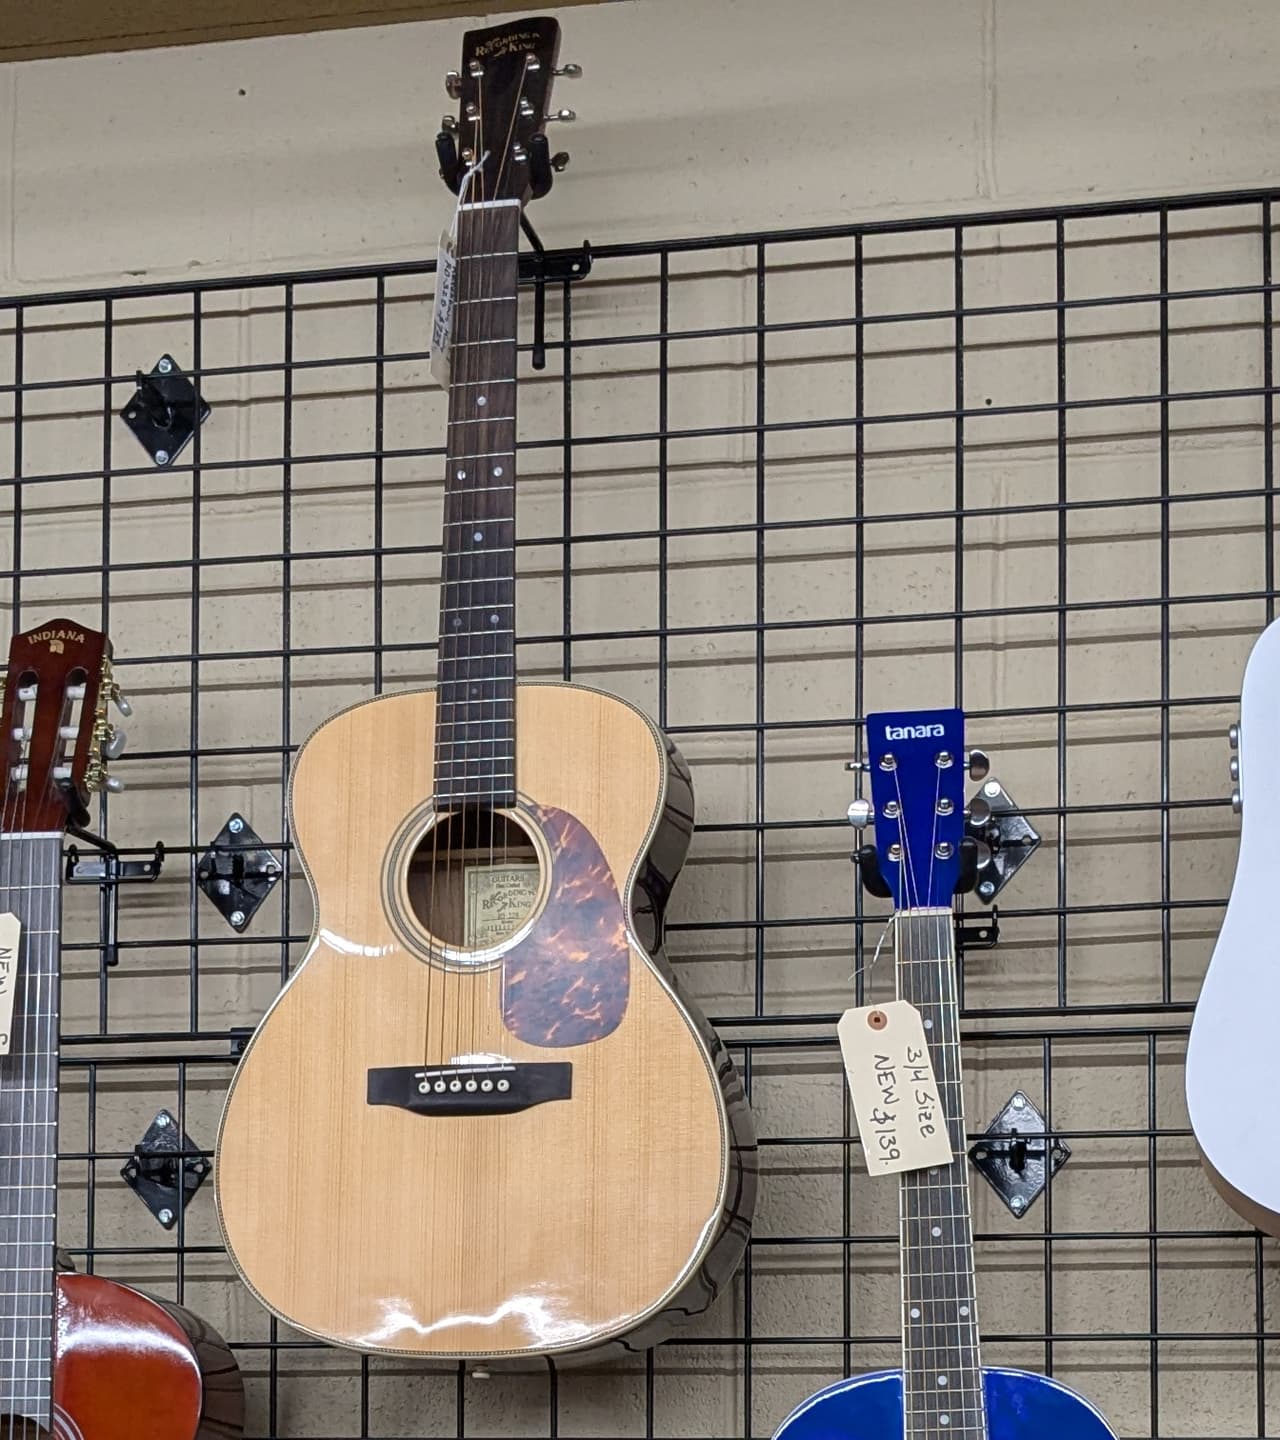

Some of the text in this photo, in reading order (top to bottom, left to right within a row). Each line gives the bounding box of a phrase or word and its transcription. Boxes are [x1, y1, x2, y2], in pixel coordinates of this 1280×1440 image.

[28, 630, 85, 645] INDIANA
[885, 723, 944, 741] tanara
[874, 1055, 900, 1105] NEW
[903, 1046, 935, 1139] 3/4 Size
